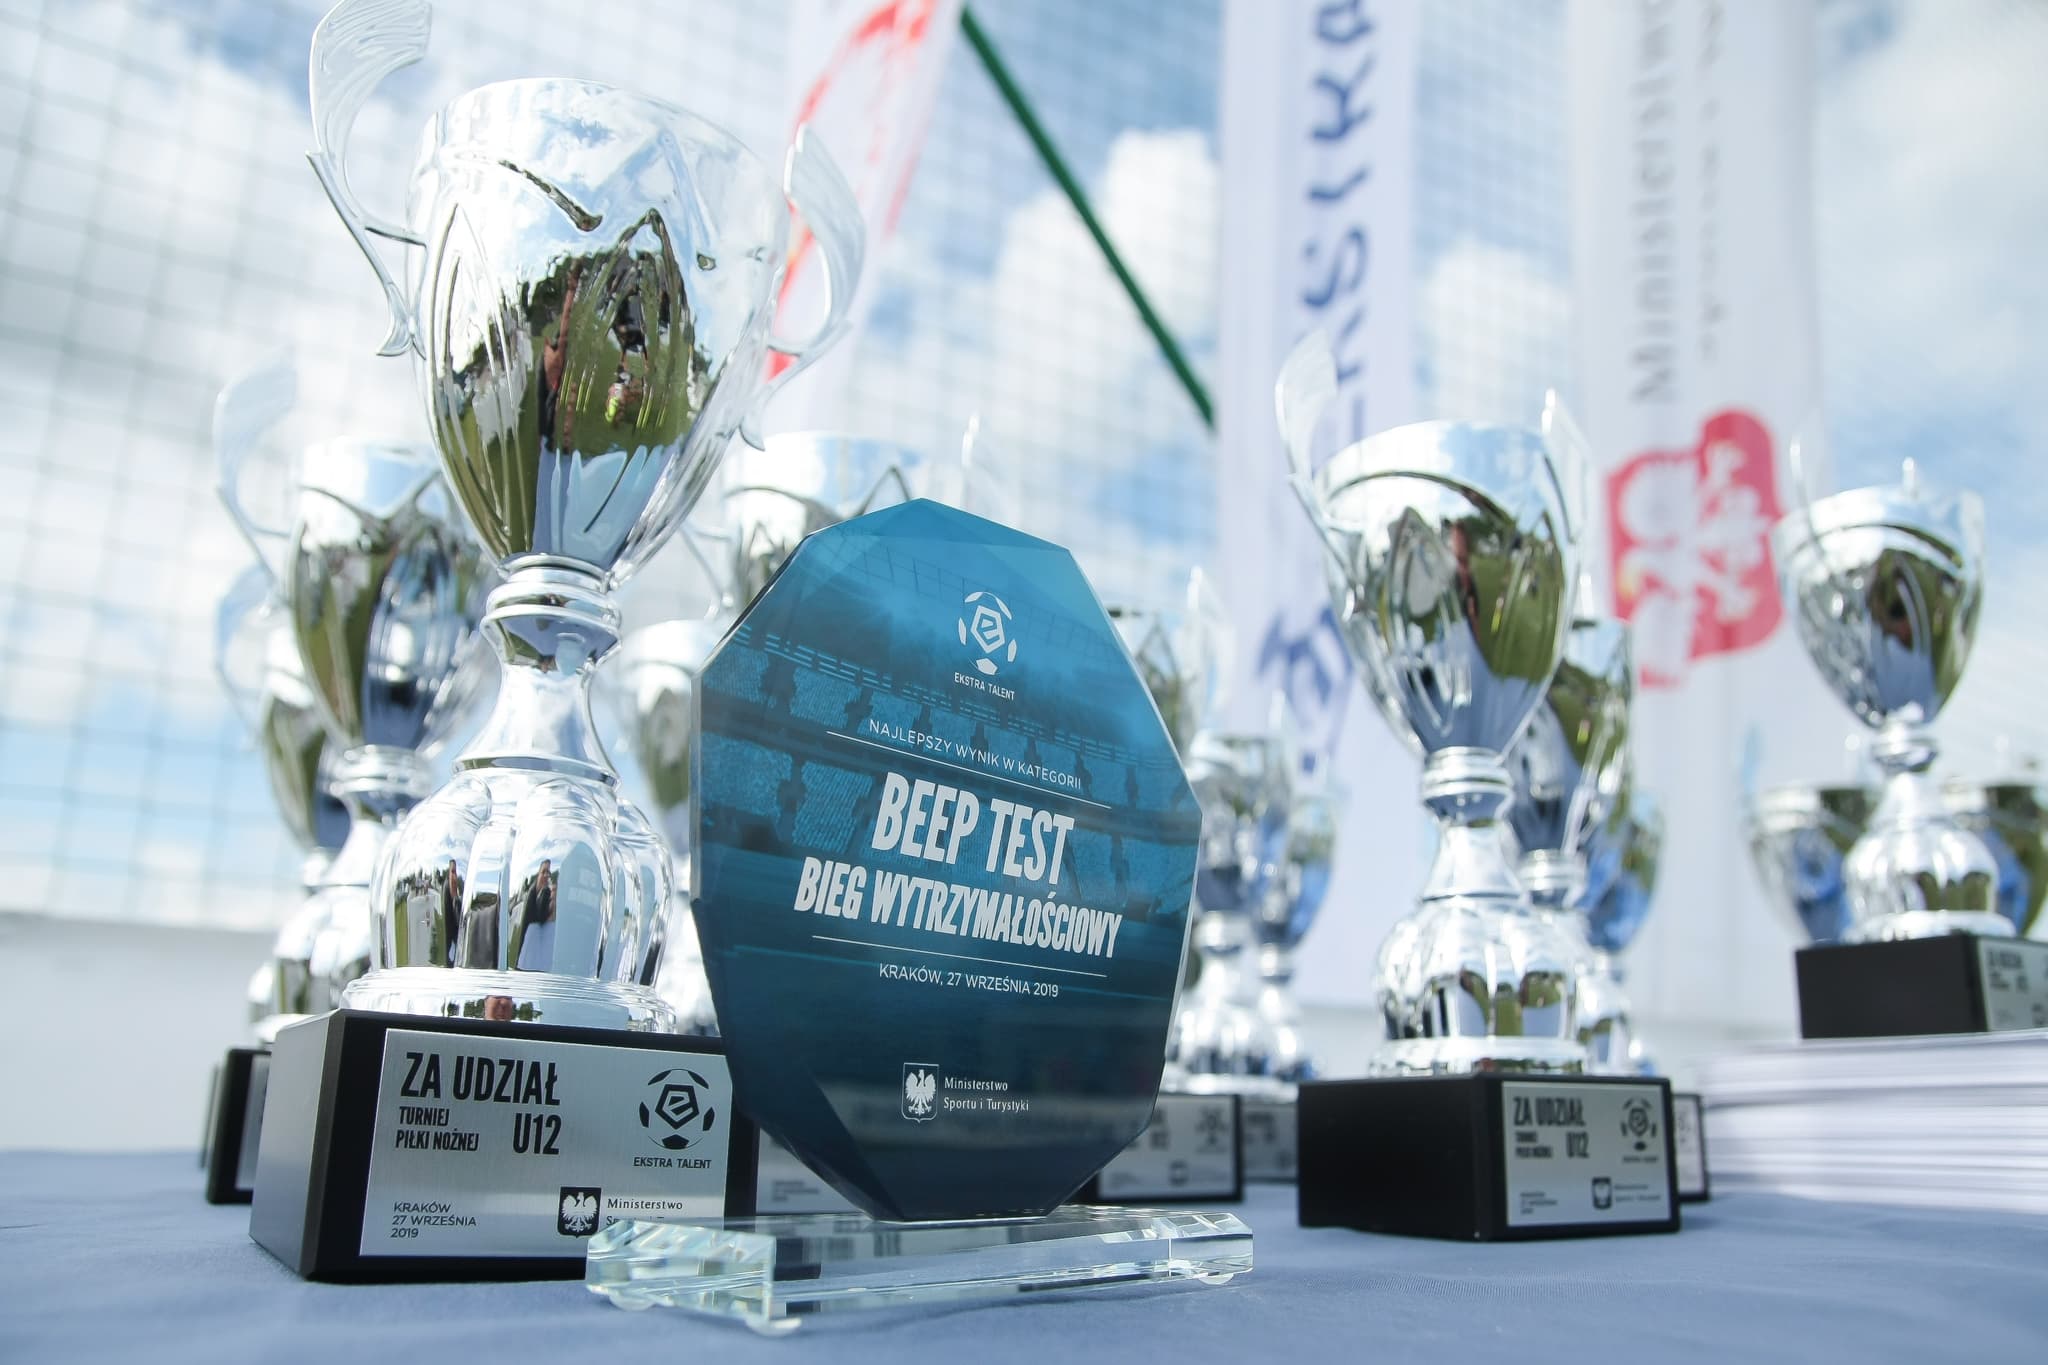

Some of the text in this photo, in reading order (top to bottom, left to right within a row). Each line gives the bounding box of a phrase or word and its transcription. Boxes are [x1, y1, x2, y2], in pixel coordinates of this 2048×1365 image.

[954, 671, 1016, 701] EKSTRA TALENT
[869, 718, 1081, 790] NAJLEPSZY WYNIK W KATEGORII
[872, 771, 1075, 885] BEEP TEST
[793, 856, 1123, 959] BIEG WYTRZYMAŁOŚCIOWY
[879, 962, 1059, 998] KRAKÓW, 27 WRZEŚNIA 2019
[400, 1051, 561, 1106] ZA UDZIAŁ
[944, 1076, 1009, 1092] Ministerstwo
[399, 1105, 450, 1127] TURNIEJ
[943, 1096, 1029, 1113] Sportu i Turystyki
[1514, 1097, 1533, 1127] ZA
[395, 1127, 480, 1152] PIŁKI NOŻNEJ
[512, 1112, 562, 1155] U12
[633, 1156, 712, 1169] EKSTRA TALENT
[393, 1201, 452, 1214] KRAKÓW
[606, 1198, 683, 1210] Ministerstwo
[388, 1227, 419, 1239] 2019
[391, 1214, 477, 1227] 27 WRZEŚNIA
